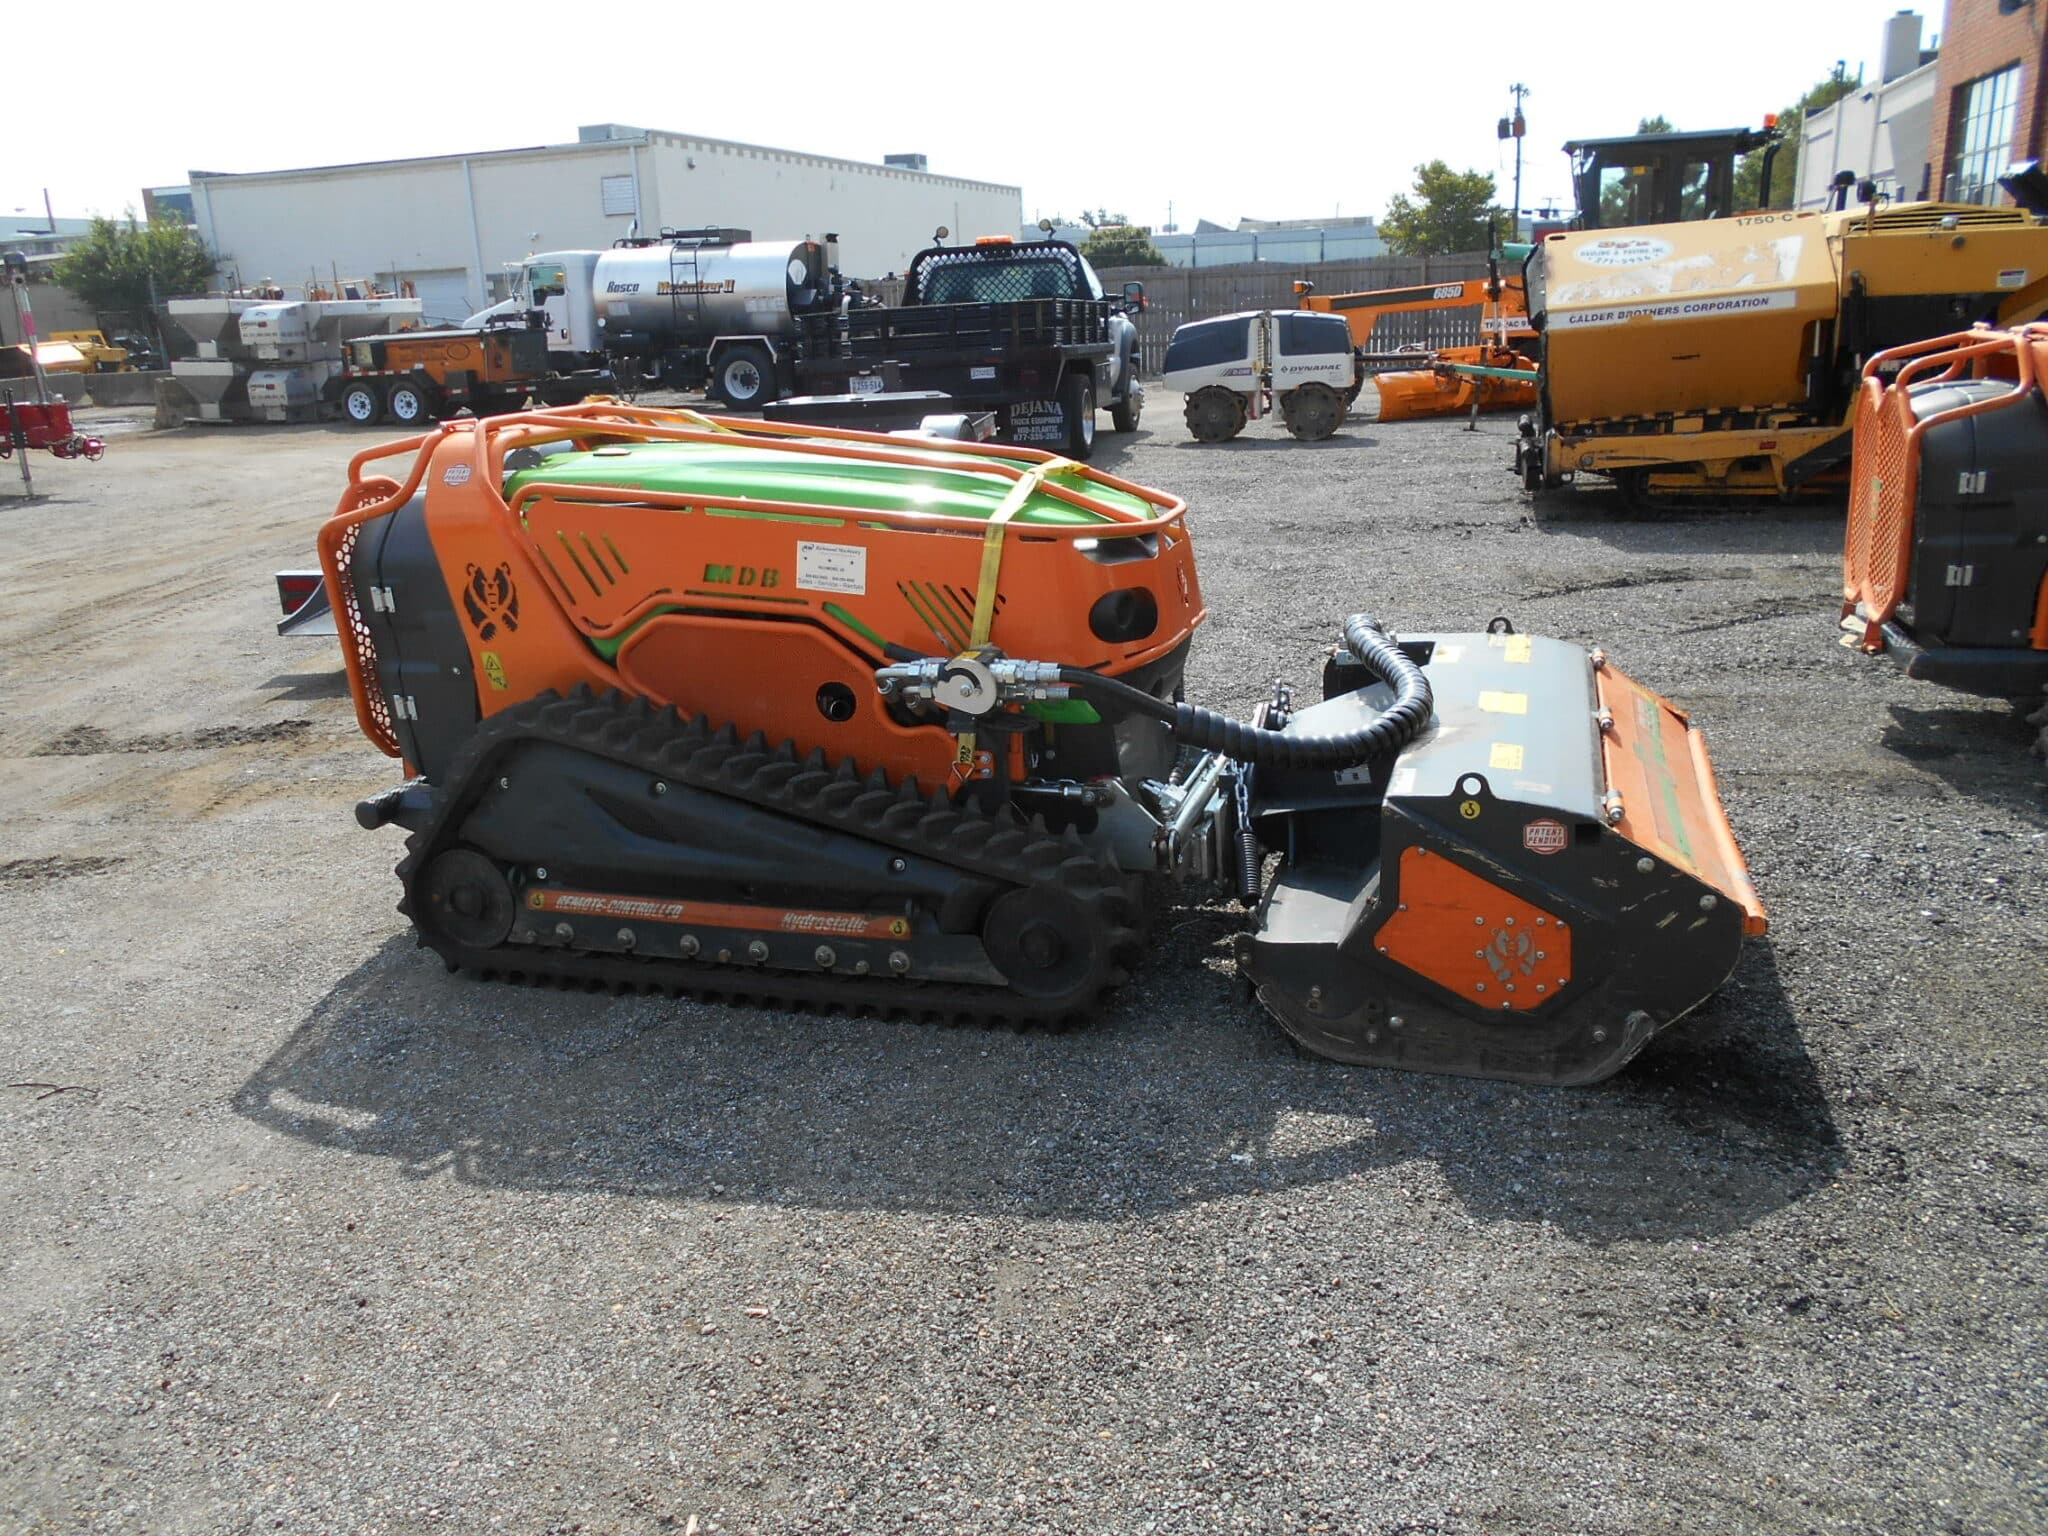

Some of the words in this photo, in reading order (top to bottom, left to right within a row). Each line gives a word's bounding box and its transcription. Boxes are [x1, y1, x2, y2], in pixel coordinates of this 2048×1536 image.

[606, 280, 640, 294] Rosco
[1568, 310, 1621, 325] CALDER
[1617, 304, 1680, 320] BROTHERS
[1682, 296, 1770, 314] CORPORATION
[1289, 364, 1342, 373] DYNAPAC
[1010, 400, 1063, 417] DEJANA
[1529, 828, 1562, 836] PATENT
[1528, 836, 1563, 845] PENDING
